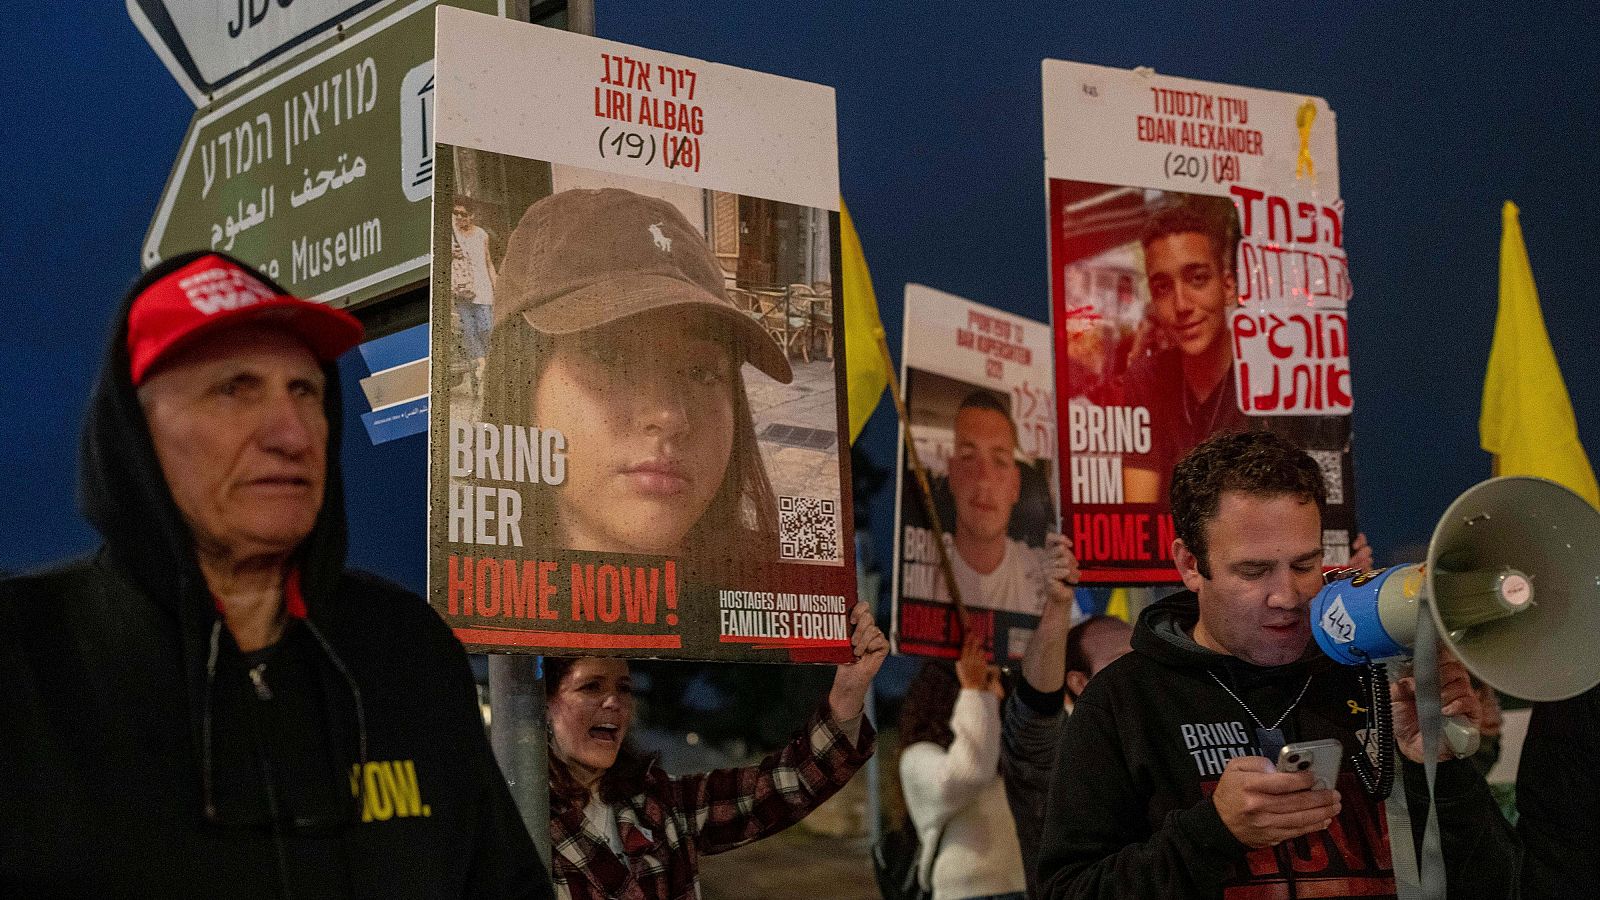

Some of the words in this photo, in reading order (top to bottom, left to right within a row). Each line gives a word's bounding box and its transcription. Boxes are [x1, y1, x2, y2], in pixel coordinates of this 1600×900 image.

[228, 0, 294, 38] JD
[601, 53, 653, 92] אלבג
[658, 64, 697, 100] לירי
[285, 56, 379, 166] מוזיאון
[594, 86, 632, 123] LIRI
[638, 96, 704, 136] ALBAG
[1151, 86, 1214, 121] אלכסנדר
[1217, 95, 1249, 125] עידן
[201, 112, 273, 200] המדע
[598, 126, 656, 167] (19)
[1136, 115, 1177, 145] EDAN
[1180, 120, 1264, 157] ALEXANDER
[290, 150, 368, 208] متحف
[1163, 151, 1208, 184] (20)
[211, 185, 275, 251] العلوم
[291, 216, 382, 285] Museum
[1233, 312, 1349, 361] הורגים
[1239, 362, 1353, 412] אותנו
[448, 420, 566, 486] BRING
[1068, 404, 1151, 454] BRING
[1071, 455, 1124, 505] HIM
[448, 484, 524, 547] HER
[1073, 512, 1151, 561] HOME
[447, 554, 558, 621] HOME
[571, 560, 680, 627] NOW!
[719, 590, 774, 612] HOSTAGES
[775, 594, 798, 612] AND
[800, 595, 847, 614] MISSING
[719, 609, 791, 638] FAMILIES
[793, 613, 848, 641] FORUM
[1328, 605, 1352, 641] 442
[1180, 721, 1249, 750] BRING
